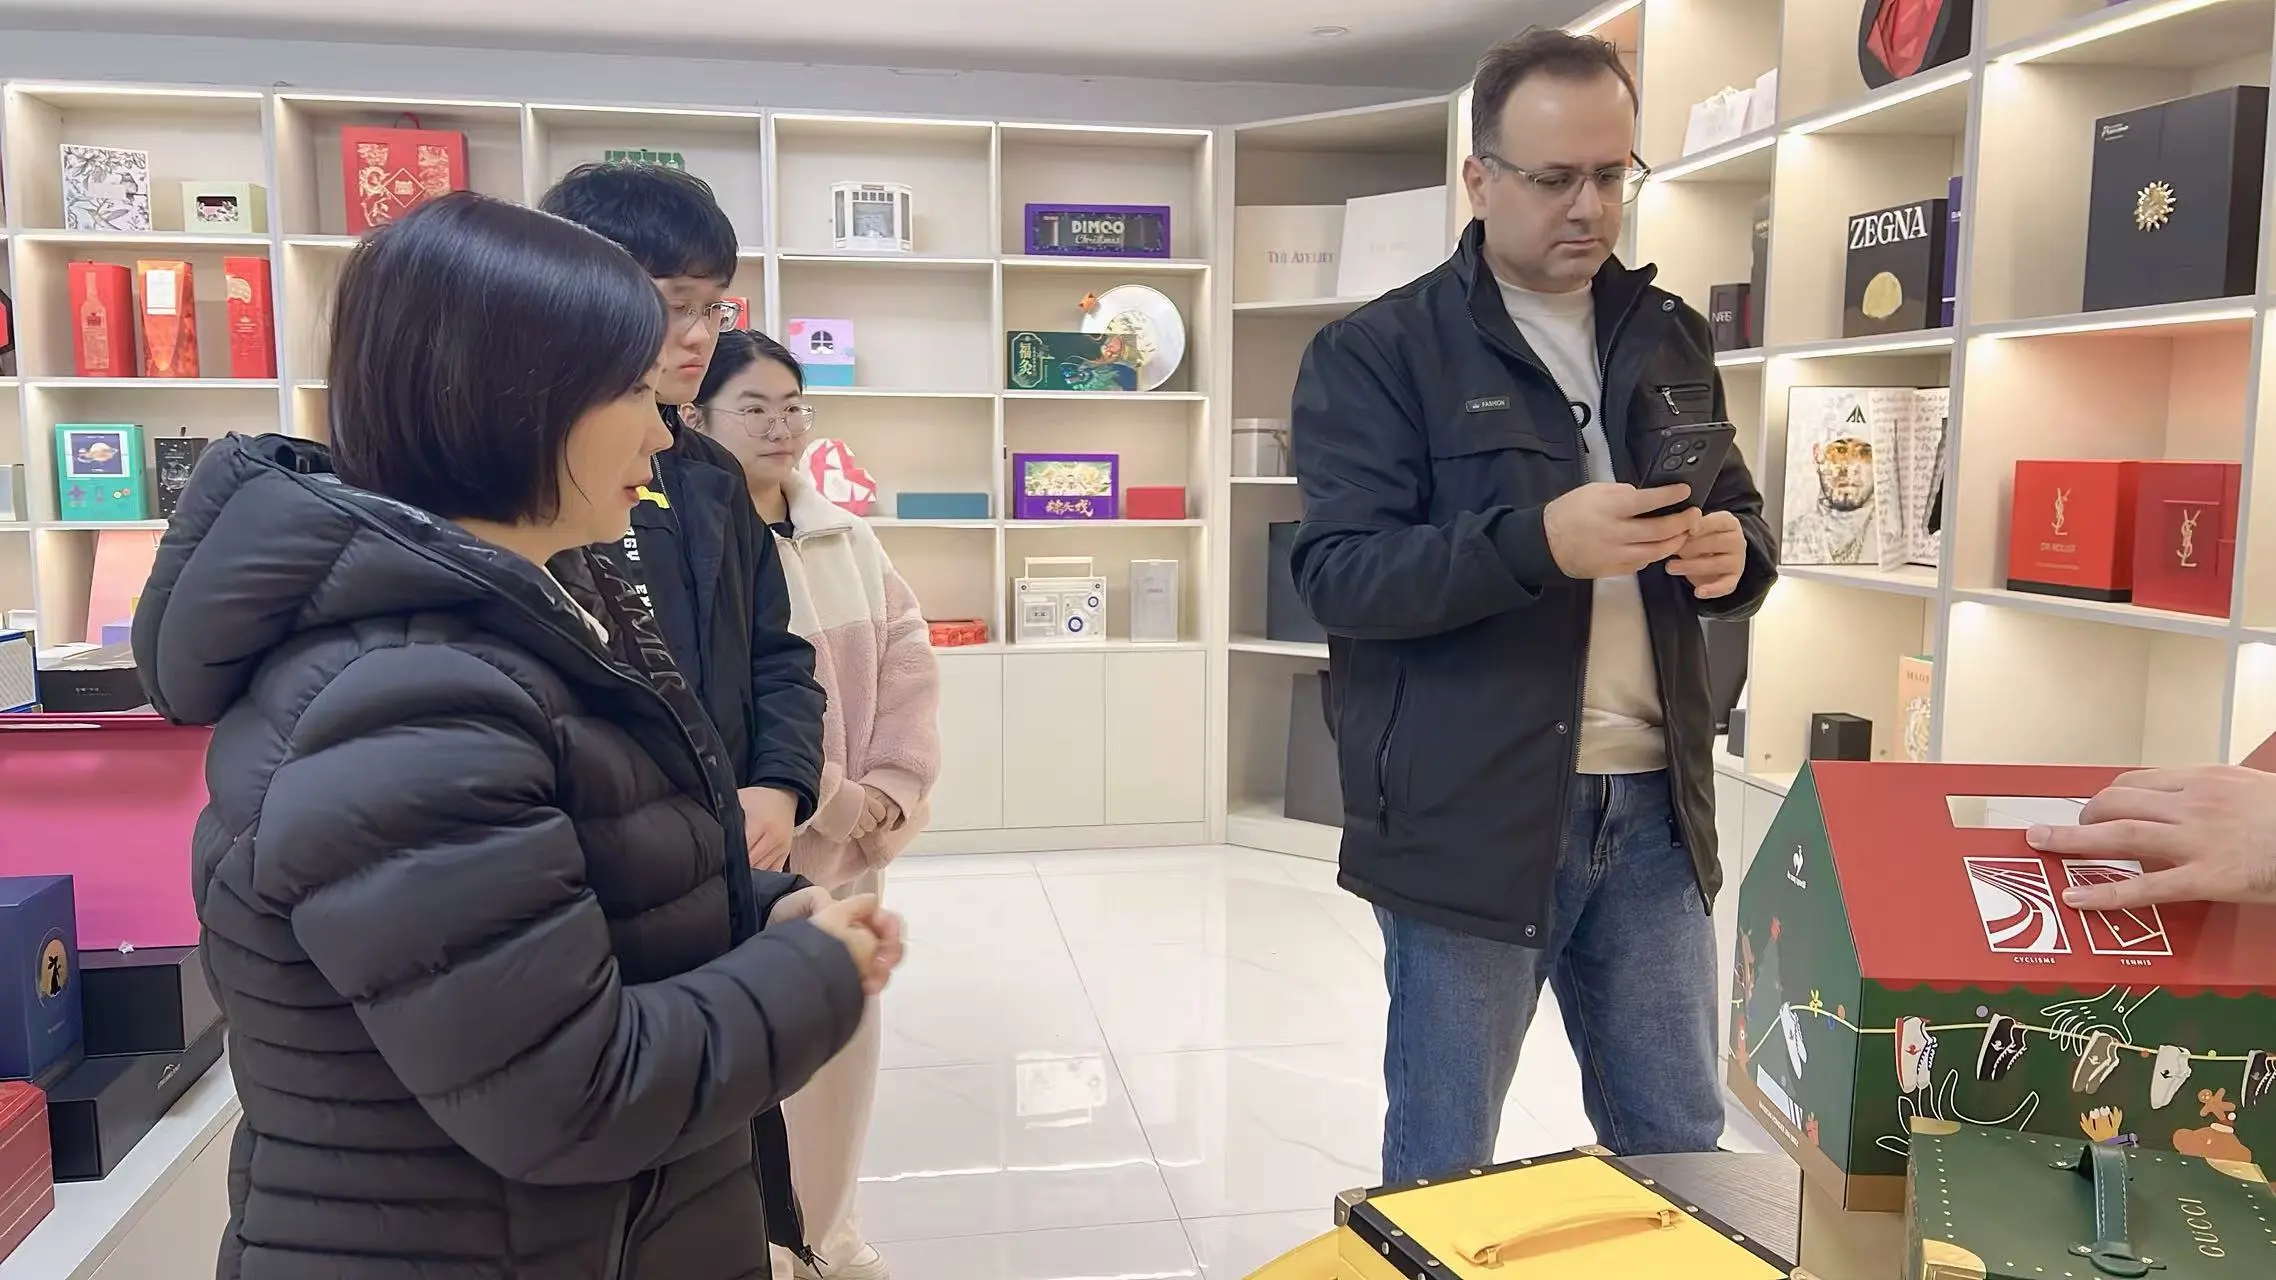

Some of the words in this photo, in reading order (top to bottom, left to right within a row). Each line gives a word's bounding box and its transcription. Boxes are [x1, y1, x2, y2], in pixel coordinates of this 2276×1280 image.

[1848, 206, 1928, 250] ZEGNA
[2013, 956, 2056, 964] CYCLISME
[2120, 958, 2152, 966] TENNIS
[2177, 1197, 2225, 1257] GUCCI
